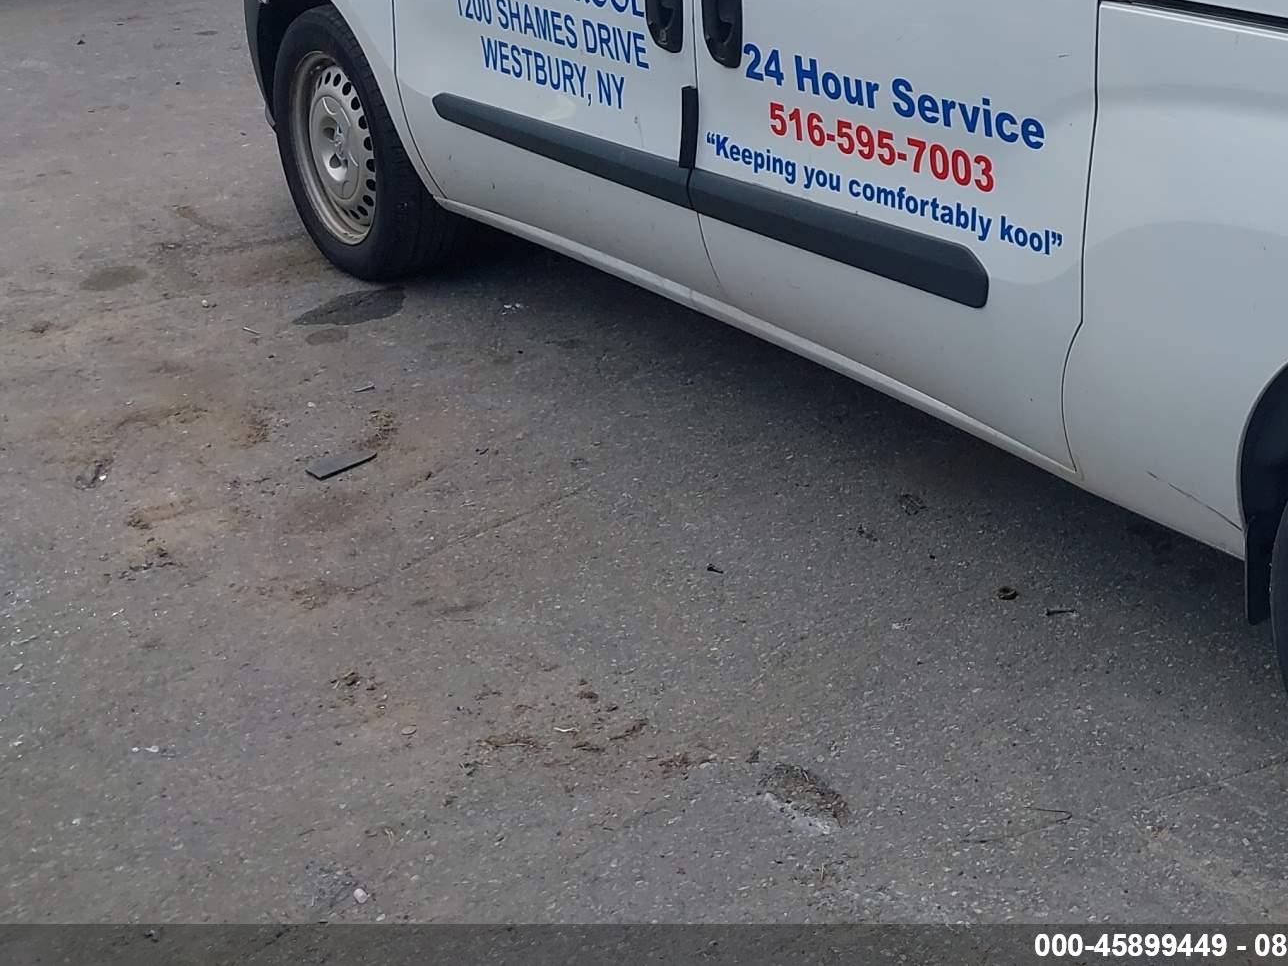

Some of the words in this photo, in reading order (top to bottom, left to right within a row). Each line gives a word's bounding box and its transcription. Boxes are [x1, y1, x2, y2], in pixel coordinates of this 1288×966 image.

[480, 35, 592, 106] WESTBURY,
[597, 70, 624, 109] NY
[582, 19, 649, 69] DRIVE
[743, 43, 784, 86] 24
[794, 55, 879, 109] Hour
[892, 78, 1046, 149] Service
[769, 102, 995, 192] 516-595-7003
[804, 165, 841, 192] you
[849, 178, 991, 242] comfortably
